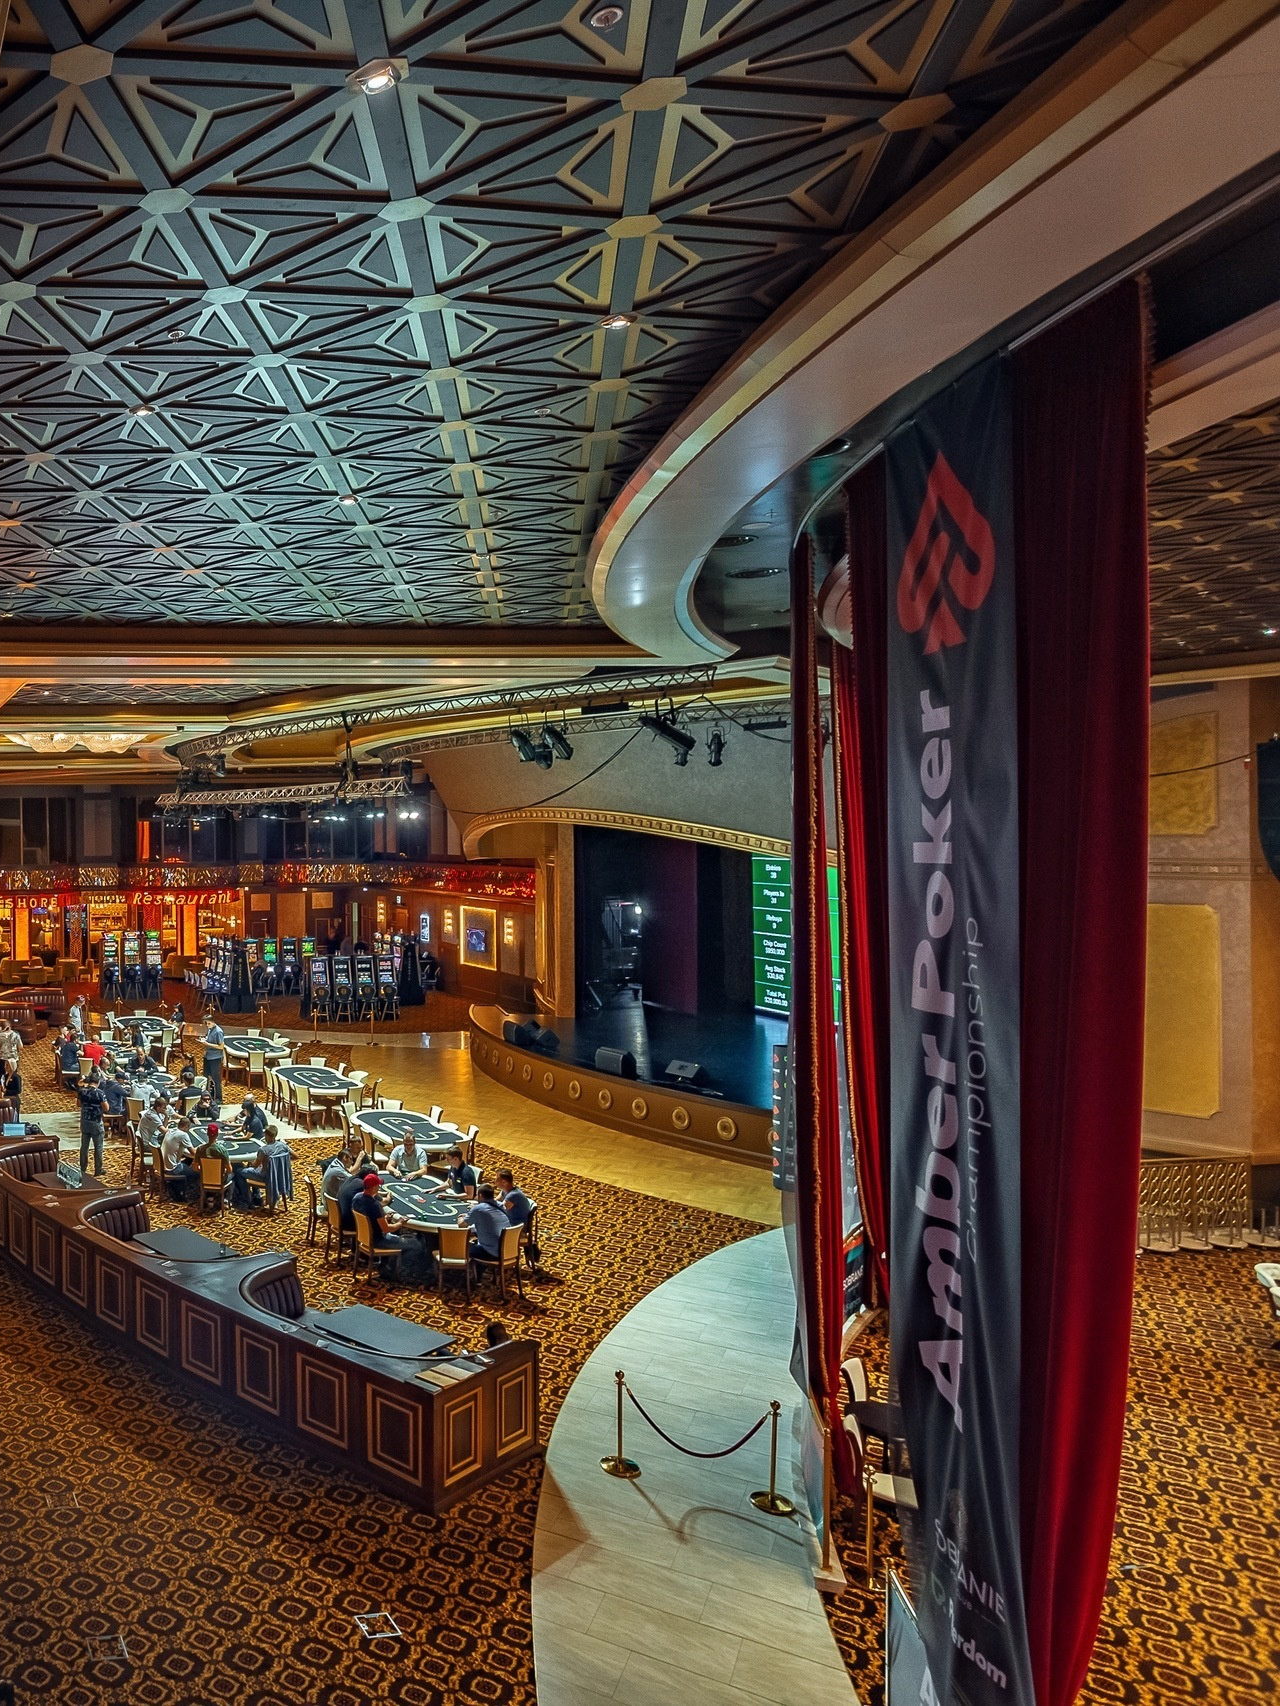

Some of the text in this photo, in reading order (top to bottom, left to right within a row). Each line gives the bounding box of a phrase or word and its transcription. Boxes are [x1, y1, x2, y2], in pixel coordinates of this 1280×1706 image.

[132, 890, 231, 905] Restaurant
[911, 690, 962, 1433] Amber Poker
[934, 1518, 1006, 1623] SBANIE
[948, 1596, 1008, 1690] Perdom
